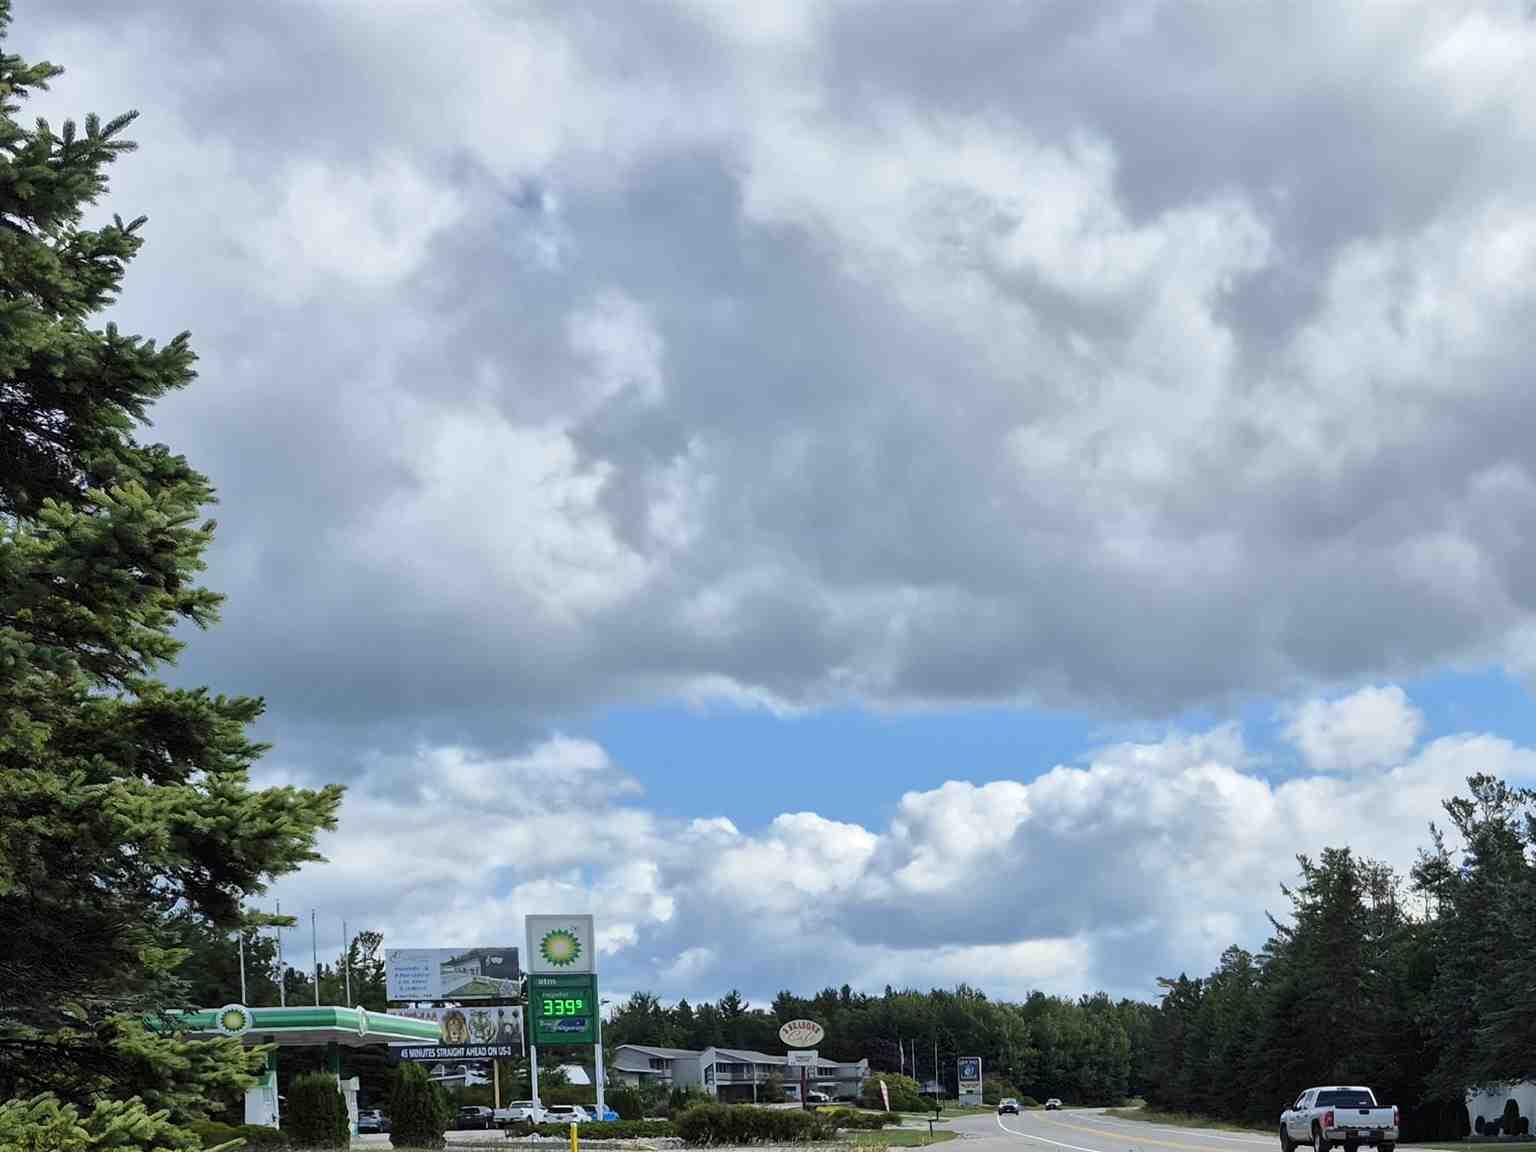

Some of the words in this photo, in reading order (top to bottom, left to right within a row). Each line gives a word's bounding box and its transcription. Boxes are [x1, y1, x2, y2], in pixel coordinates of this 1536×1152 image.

[409, 1047, 436, 1058] MINUTES
[436, 1047, 465, 1057] STRAIGHT
[465, 1046, 487, 1057] AHEAD
[487, 1046, 498, 1056] ON
